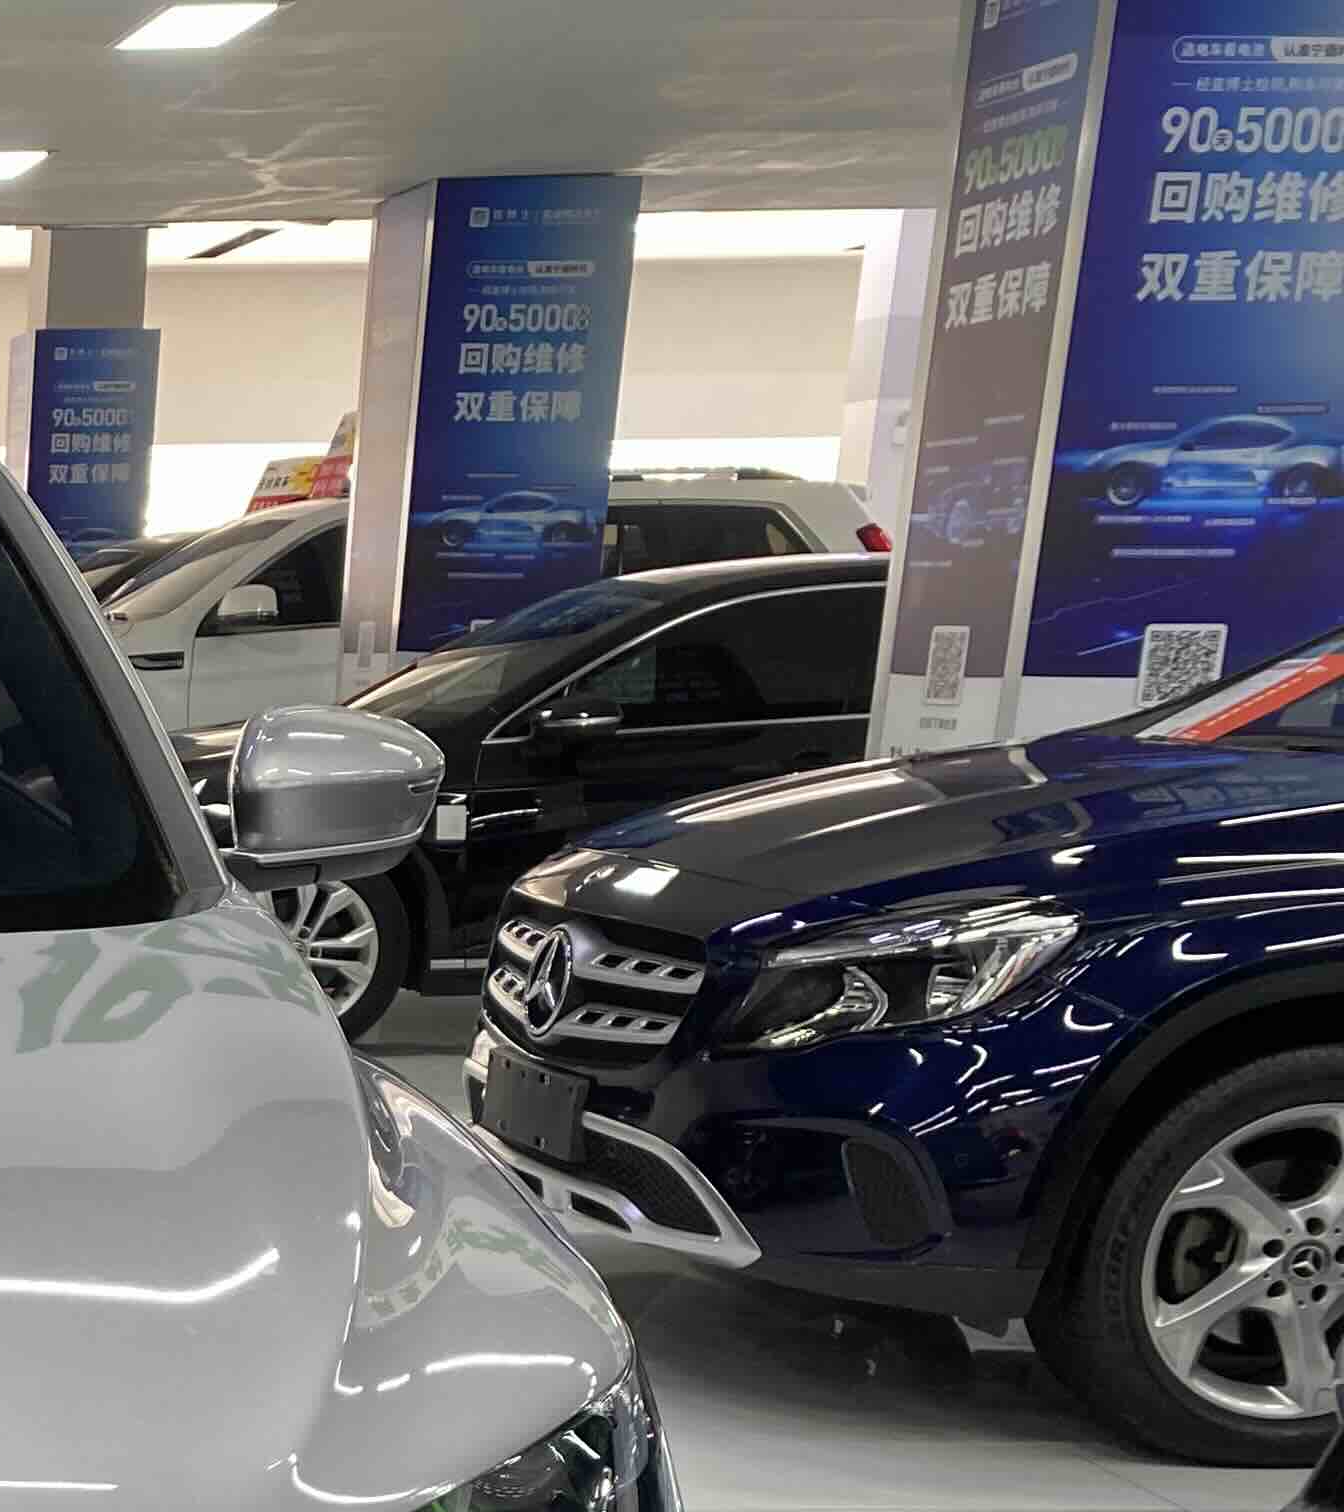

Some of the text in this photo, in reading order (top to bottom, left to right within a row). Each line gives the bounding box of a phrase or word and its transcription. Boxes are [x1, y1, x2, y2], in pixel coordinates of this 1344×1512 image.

[955, 184, 1060, 258] 回购维修
[1149, 171, 1344, 223] 回购维修
[945, 261, 1050, 331] 双重保障
[1137, 251, 1344, 302] 双重保障
[459, 343, 585, 375] 回购维修
[454, 391, 582, 422] 双重保障
